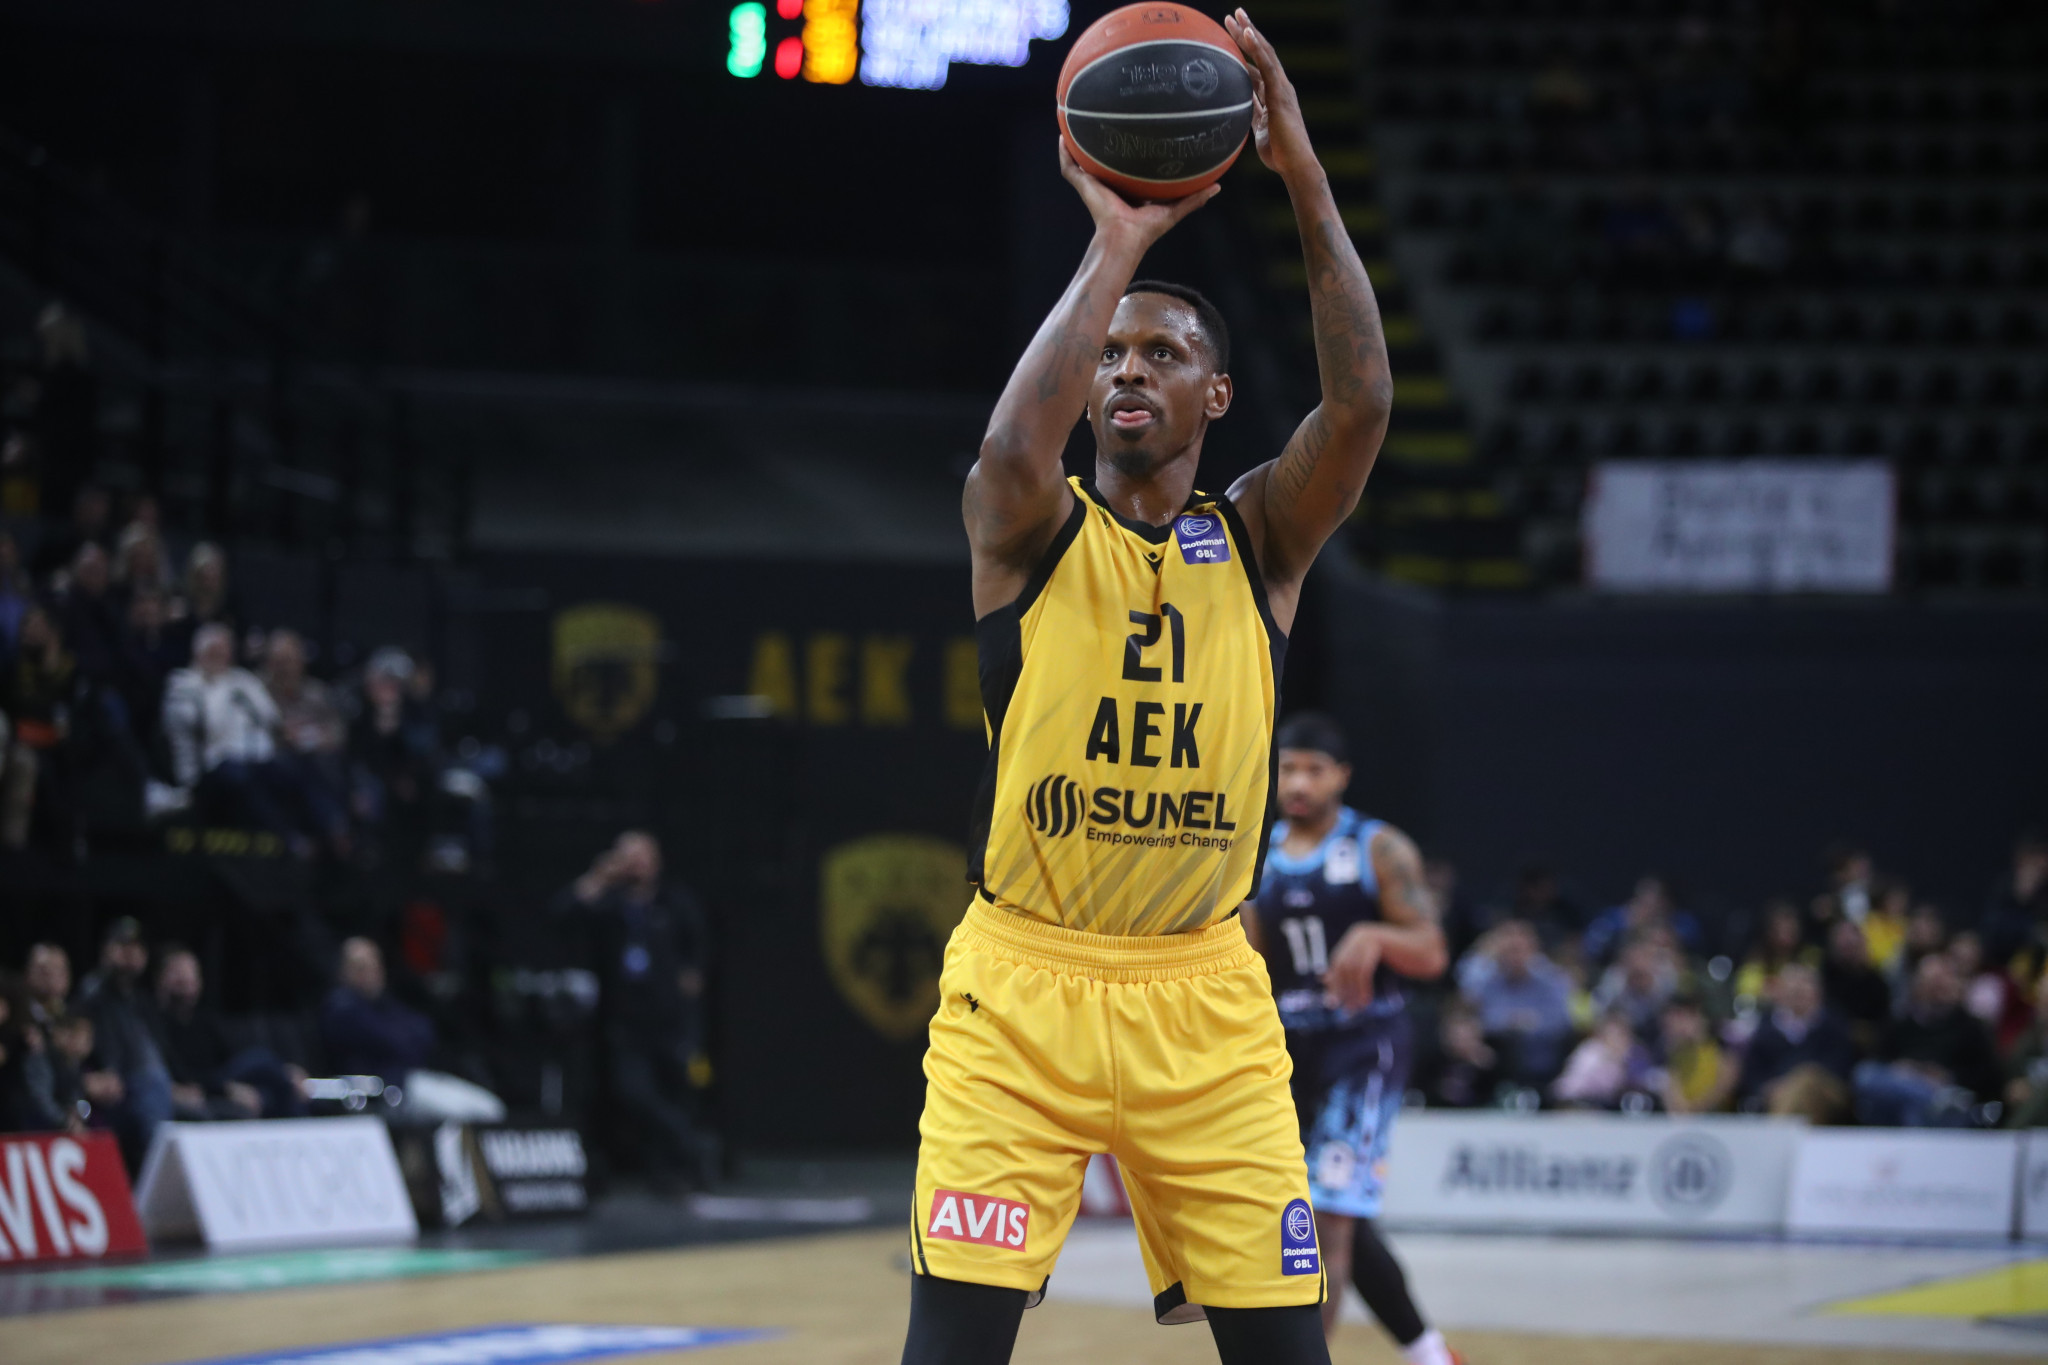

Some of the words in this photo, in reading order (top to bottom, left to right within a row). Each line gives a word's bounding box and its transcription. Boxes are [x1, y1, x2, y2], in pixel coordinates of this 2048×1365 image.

[1100, 119, 1231, 159] SPALDING
[1195, 549, 1217, 559] GBL
[1122, 602, 1186, 683] 21
[748, 632, 911, 725] AEK
[1085, 696, 1204, 768] AEK
[1088, 787, 1236, 831] SUNEL
[1086, 827, 1177, 848] Empowering
[1281, 916, 1328, 975] 11
[1442, 1142, 1637, 1197] Allianz
[0, 1137, 109, 1261] VIS
[930, 1196, 1027, 1246] AVIS
[1293, 1259, 1313, 1269] GBL
